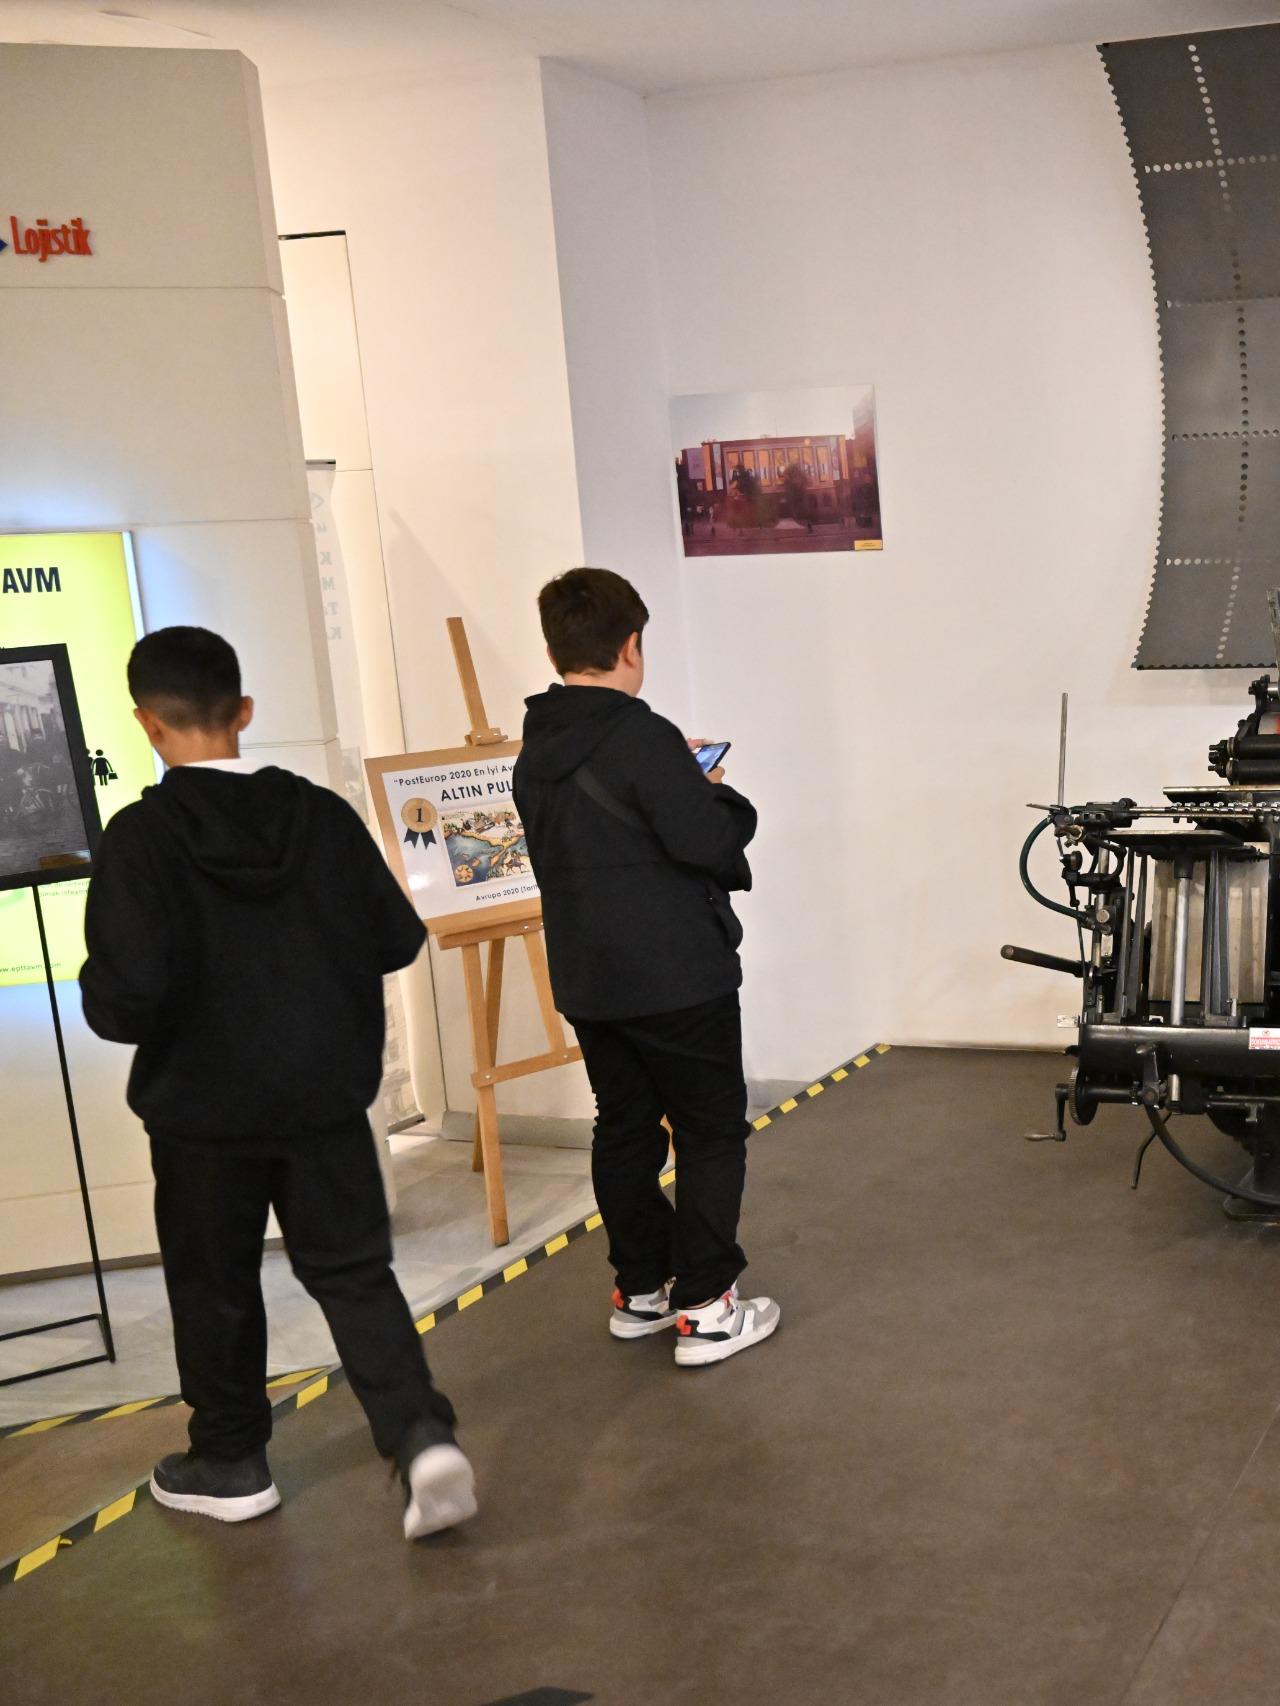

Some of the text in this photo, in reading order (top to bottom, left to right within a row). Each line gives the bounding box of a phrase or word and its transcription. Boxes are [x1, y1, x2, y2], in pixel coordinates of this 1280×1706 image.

[10, 216, 93, 262] Lojistik
[2, 566, 62, 594] AVM
[449, 768, 472, 781] 2020
[473, 767, 486, 778] En
[441, 784, 483, 802] ALTIN
[415, 807, 424, 823] 1
[502, 886, 521, 897] 2020
